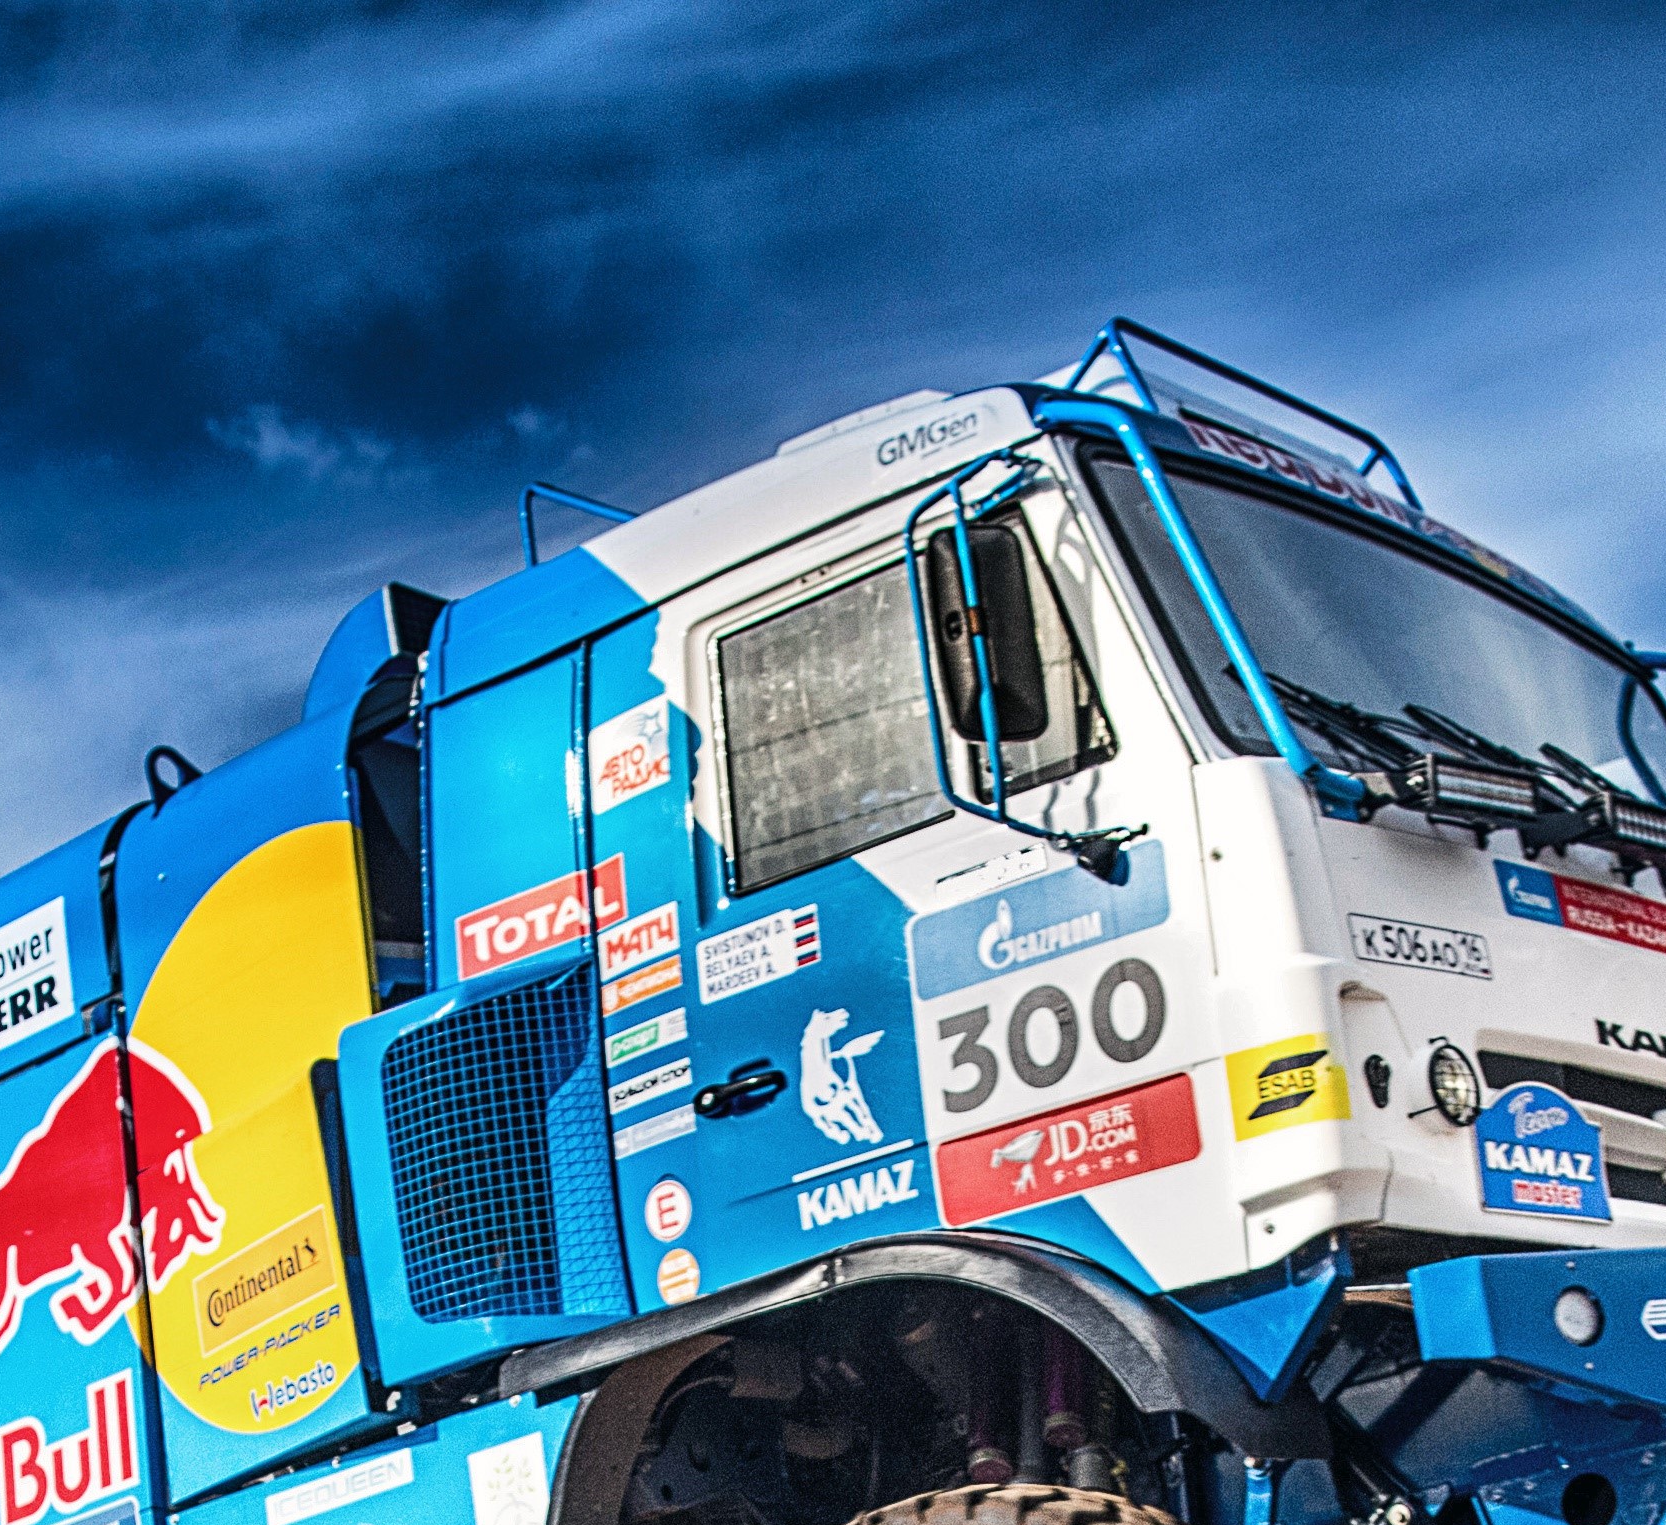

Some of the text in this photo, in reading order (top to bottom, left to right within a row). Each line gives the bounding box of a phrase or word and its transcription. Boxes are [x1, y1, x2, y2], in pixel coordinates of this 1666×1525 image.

[877, 411, 978, 466] GMGen
[464, 887, 621, 962] TOTAL
[937, 956, 1167, 1113] 300
[1257, 1069, 1317, 1100] ESAB
[1483, 1140, 1596, 1183] KAMAZ
[656, 1192, 679, 1230] E
[796, 1160, 920, 1231] KAMAZ
[207, 1244, 303, 1327] Continental
[198, 1303, 341, 1391] POWER-PACKER
[250, 1360, 335, 1418] Webasto
